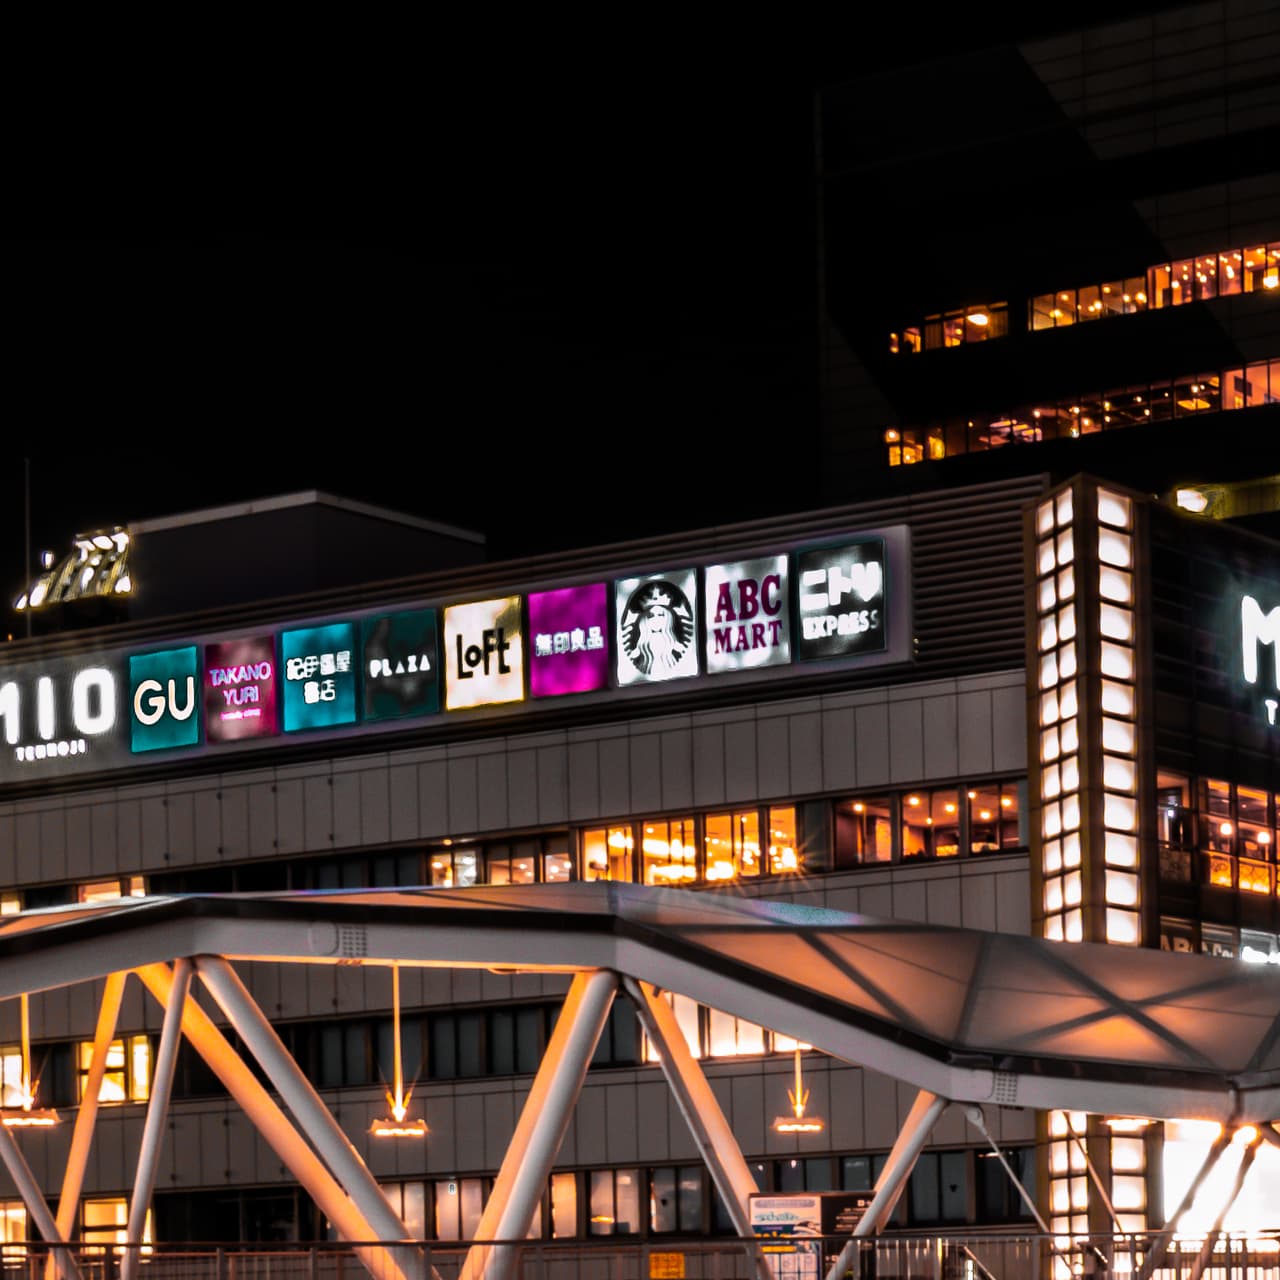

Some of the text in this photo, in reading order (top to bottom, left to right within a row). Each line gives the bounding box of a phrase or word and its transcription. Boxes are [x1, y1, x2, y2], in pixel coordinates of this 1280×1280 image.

[713, 574, 782, 624] ABC
[713, 619, 783, 655] MART
[802, 608, 879, 641] EXPRESS
[535, 625, 604, 657] 無印良品
[209, 661, 272, 687] TAKANO
[369, 653, 431, 678] PLAZA
[134, 676, 195, 726] GU
[222, 685, 260, 706] YURI
